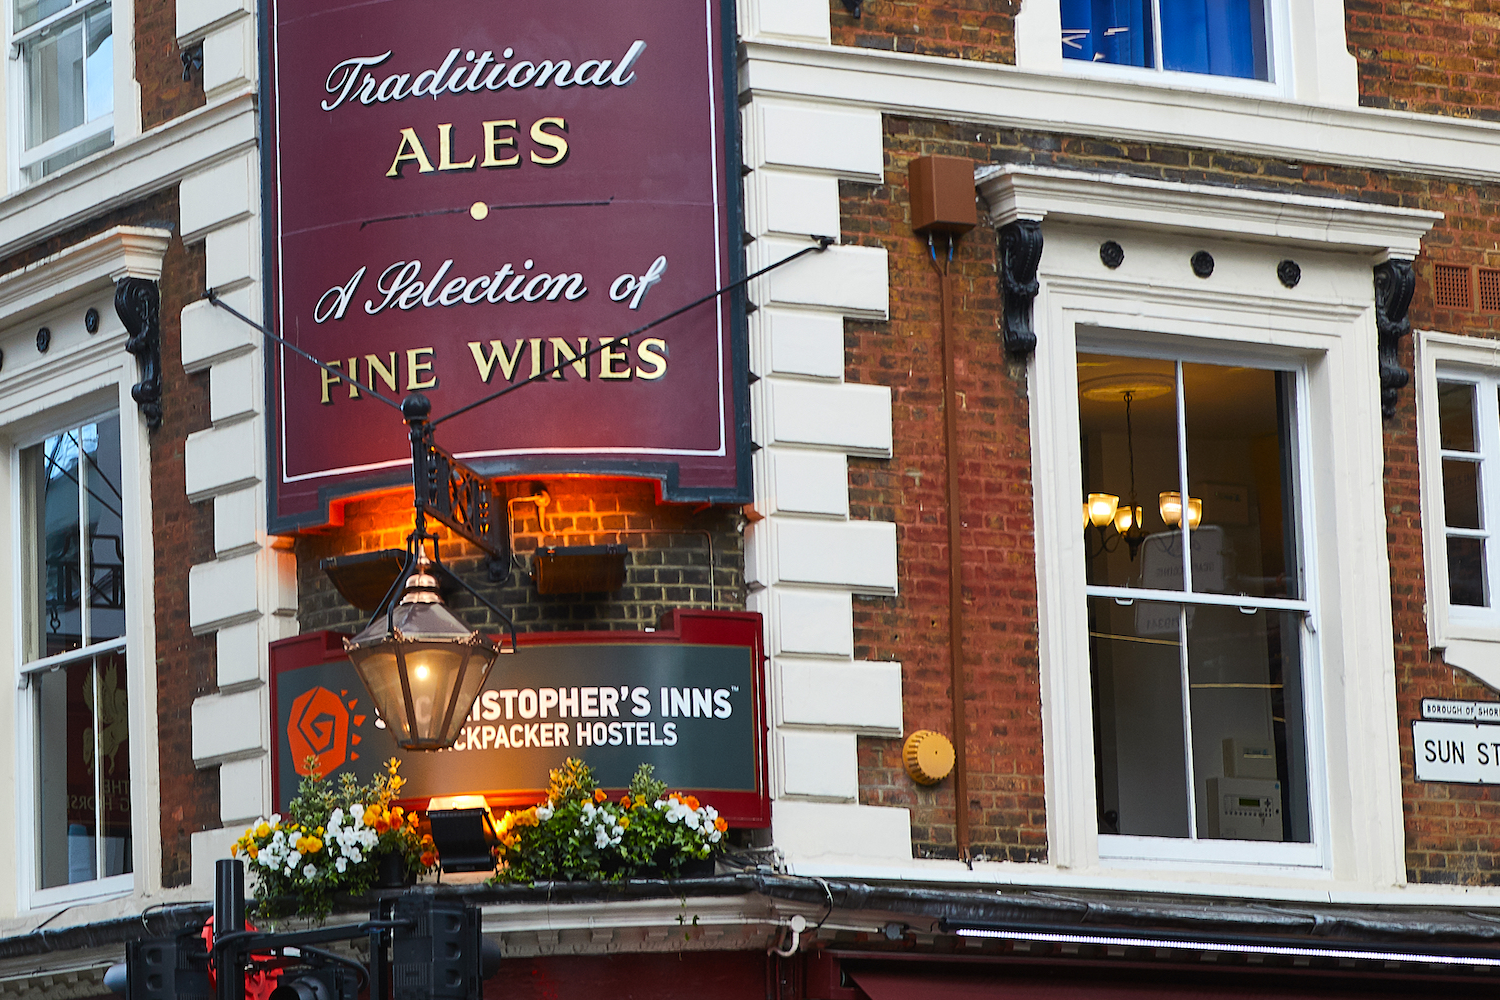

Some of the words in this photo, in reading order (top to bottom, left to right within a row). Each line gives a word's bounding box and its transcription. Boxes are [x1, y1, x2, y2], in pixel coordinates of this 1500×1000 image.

[320, 40, 646, 112] Traditional
[385, 116, 570, 177] ALES
[313, 265, 366, 324] A
[364, 258, 586, 314] Selection
[609, 255, 668, 310] of
[320, 346, 438, 404] FINE
[467, 336, 669, 383] WINES
[577, 721, 678, 747] HOSTELS
[1427, 705, 1462, 715] BOROUGH
[1465, 707, 1474, 716] OF
[1478, 706, 1500, 717] SHOR
[1424, 739, 1466, 765] SUN
